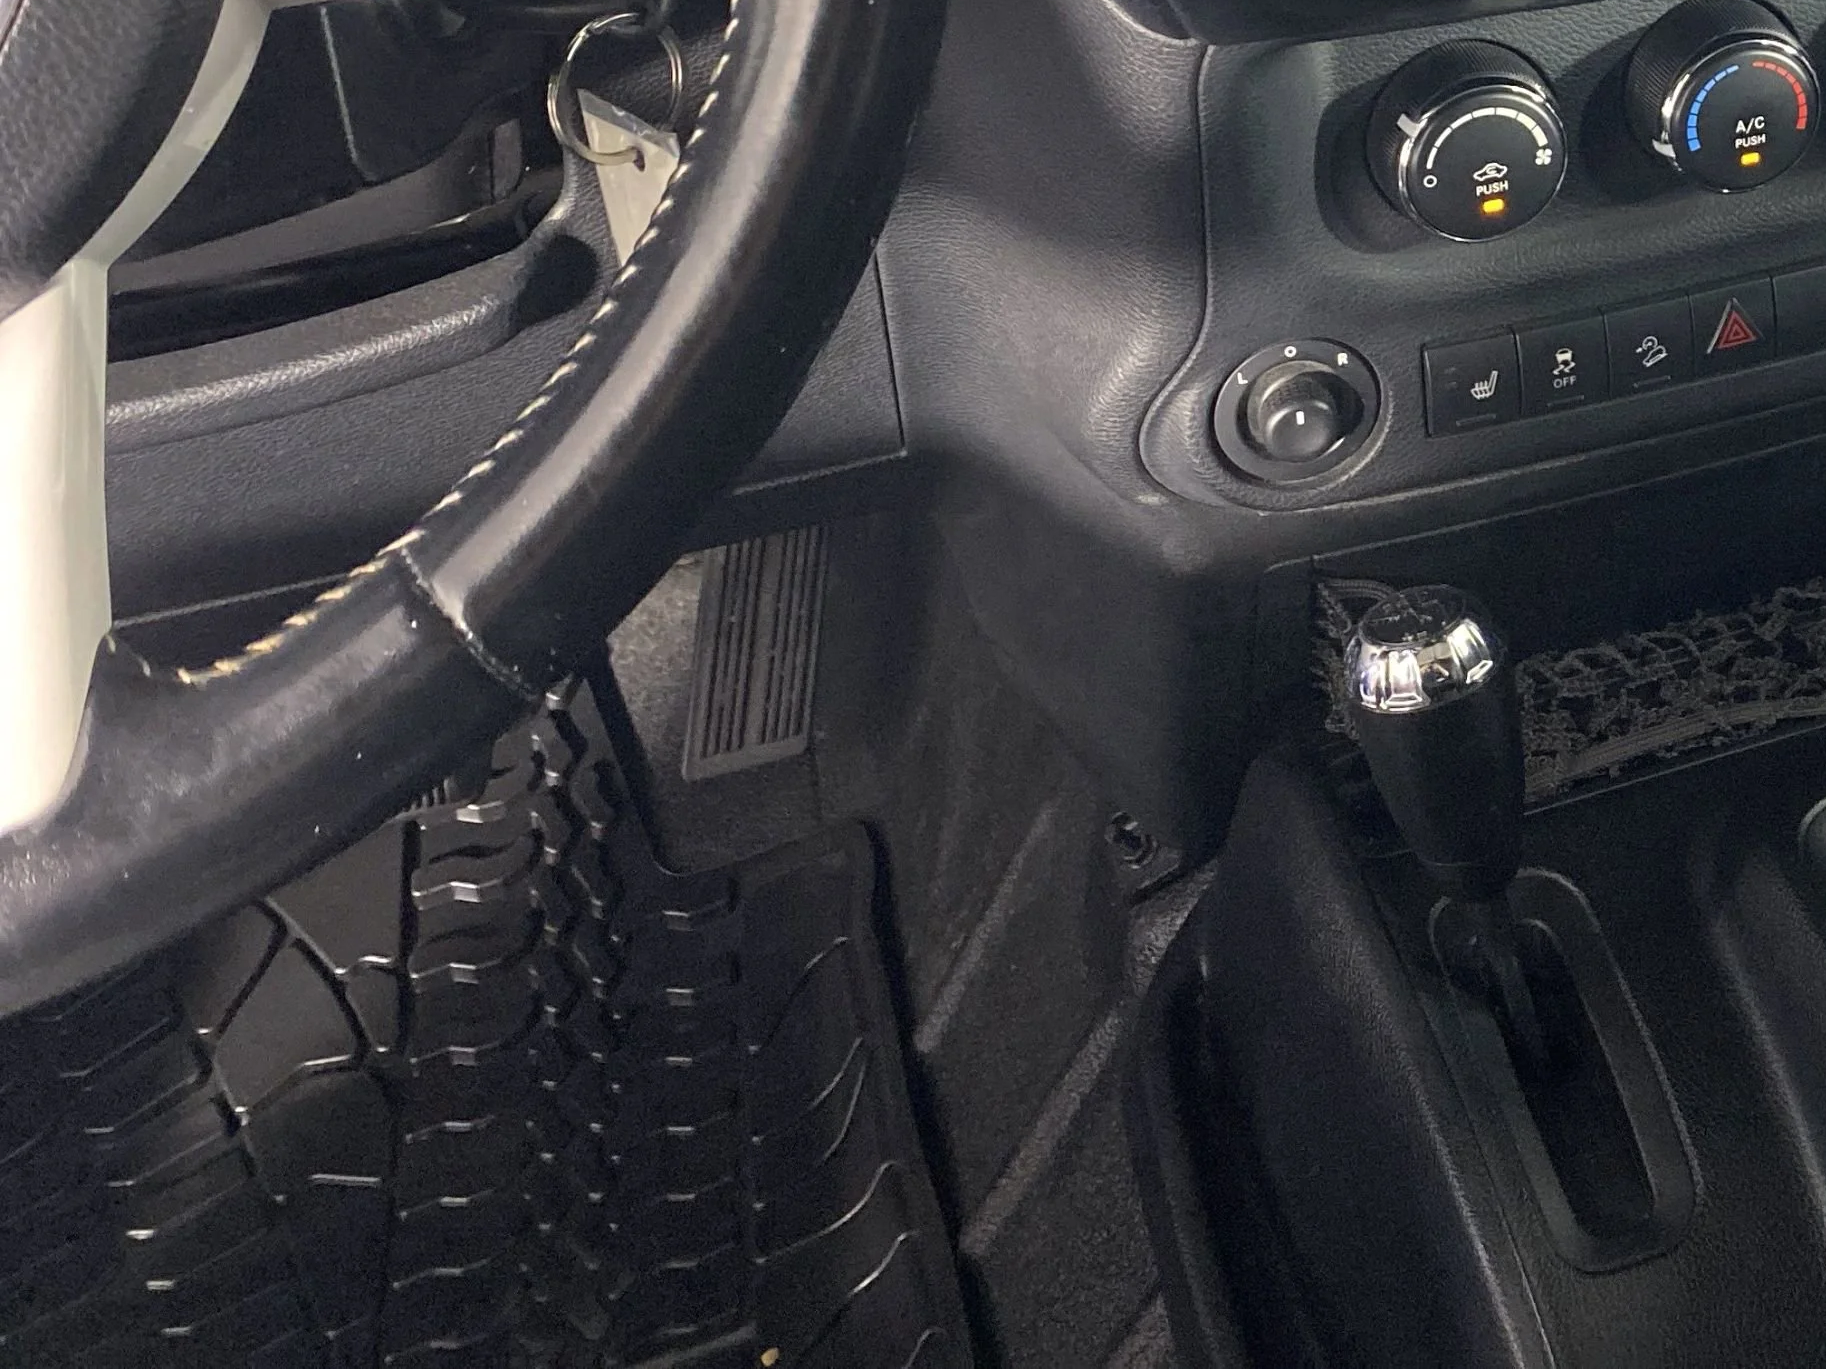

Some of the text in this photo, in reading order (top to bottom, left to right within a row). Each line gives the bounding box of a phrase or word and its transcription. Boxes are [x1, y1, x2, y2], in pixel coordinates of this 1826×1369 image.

[1735, 114, 1765, 133] A/C
[1734, 132, 1766, 150] PUSH
[1475, 179, 1509, 198] PUSH
[1337, 352, 1349, 366] R
[1237, 372, 1249, 385] L
[1552, 374, 1577, 390] OFF
